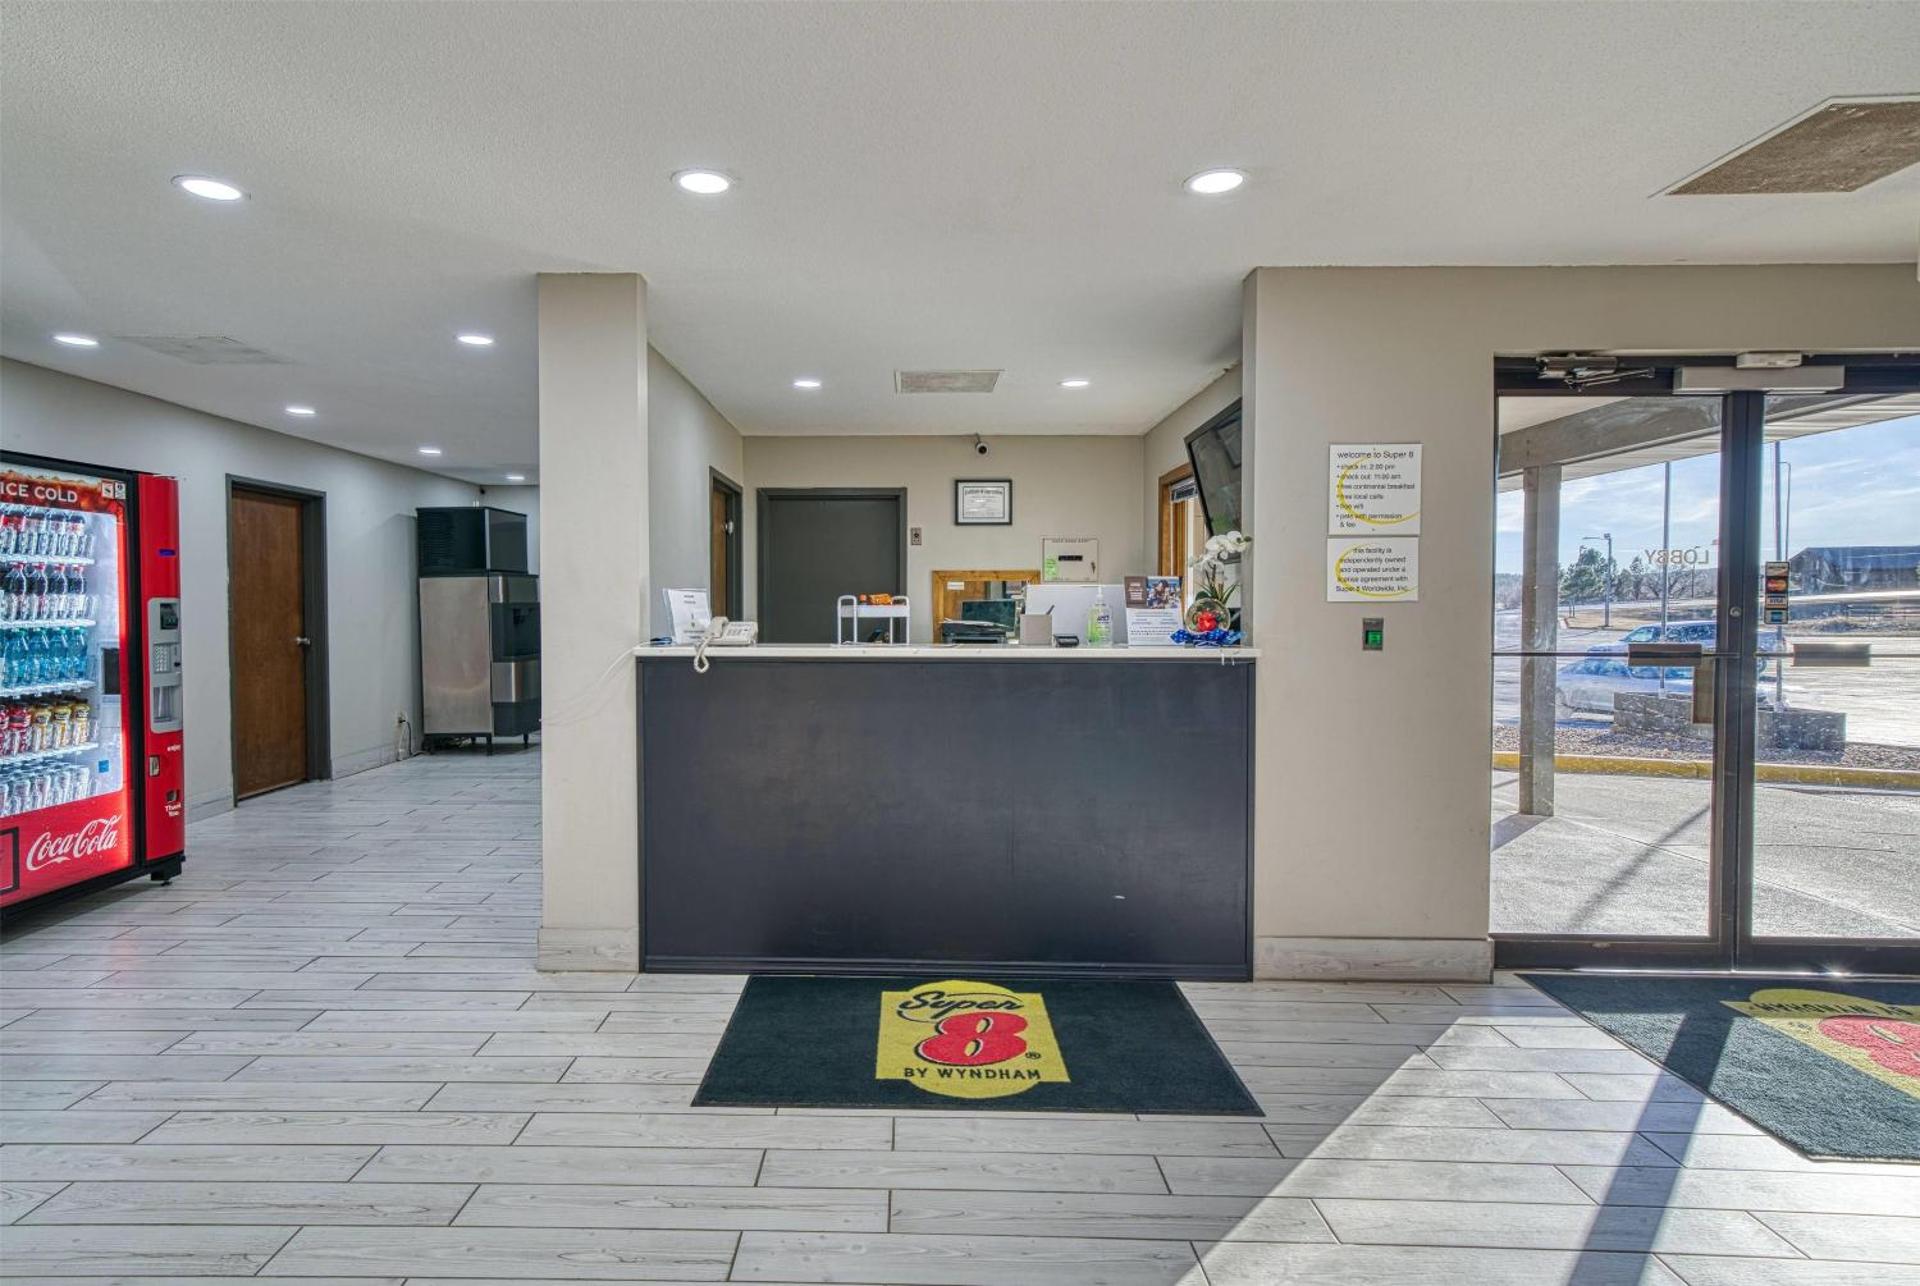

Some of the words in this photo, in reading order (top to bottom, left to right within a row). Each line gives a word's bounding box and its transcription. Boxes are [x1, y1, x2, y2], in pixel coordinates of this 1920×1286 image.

[1337, 451, 1372, 459] welcome
[1374, 451, 1381, 459] to
[1383, 451, 1407, 460] Super
[0, 482, 29, 498] ICE
[34, 486, 78, 503] COLD
[26, 814, 122, 871] Coca-Cola
[898, 991, 1024, 1024] Super
[914, 1012, 1028, 1066] 8
[904, 1067, 928, 1078] BY
[938, 1068, 1041, 1080] WYNDHAM
